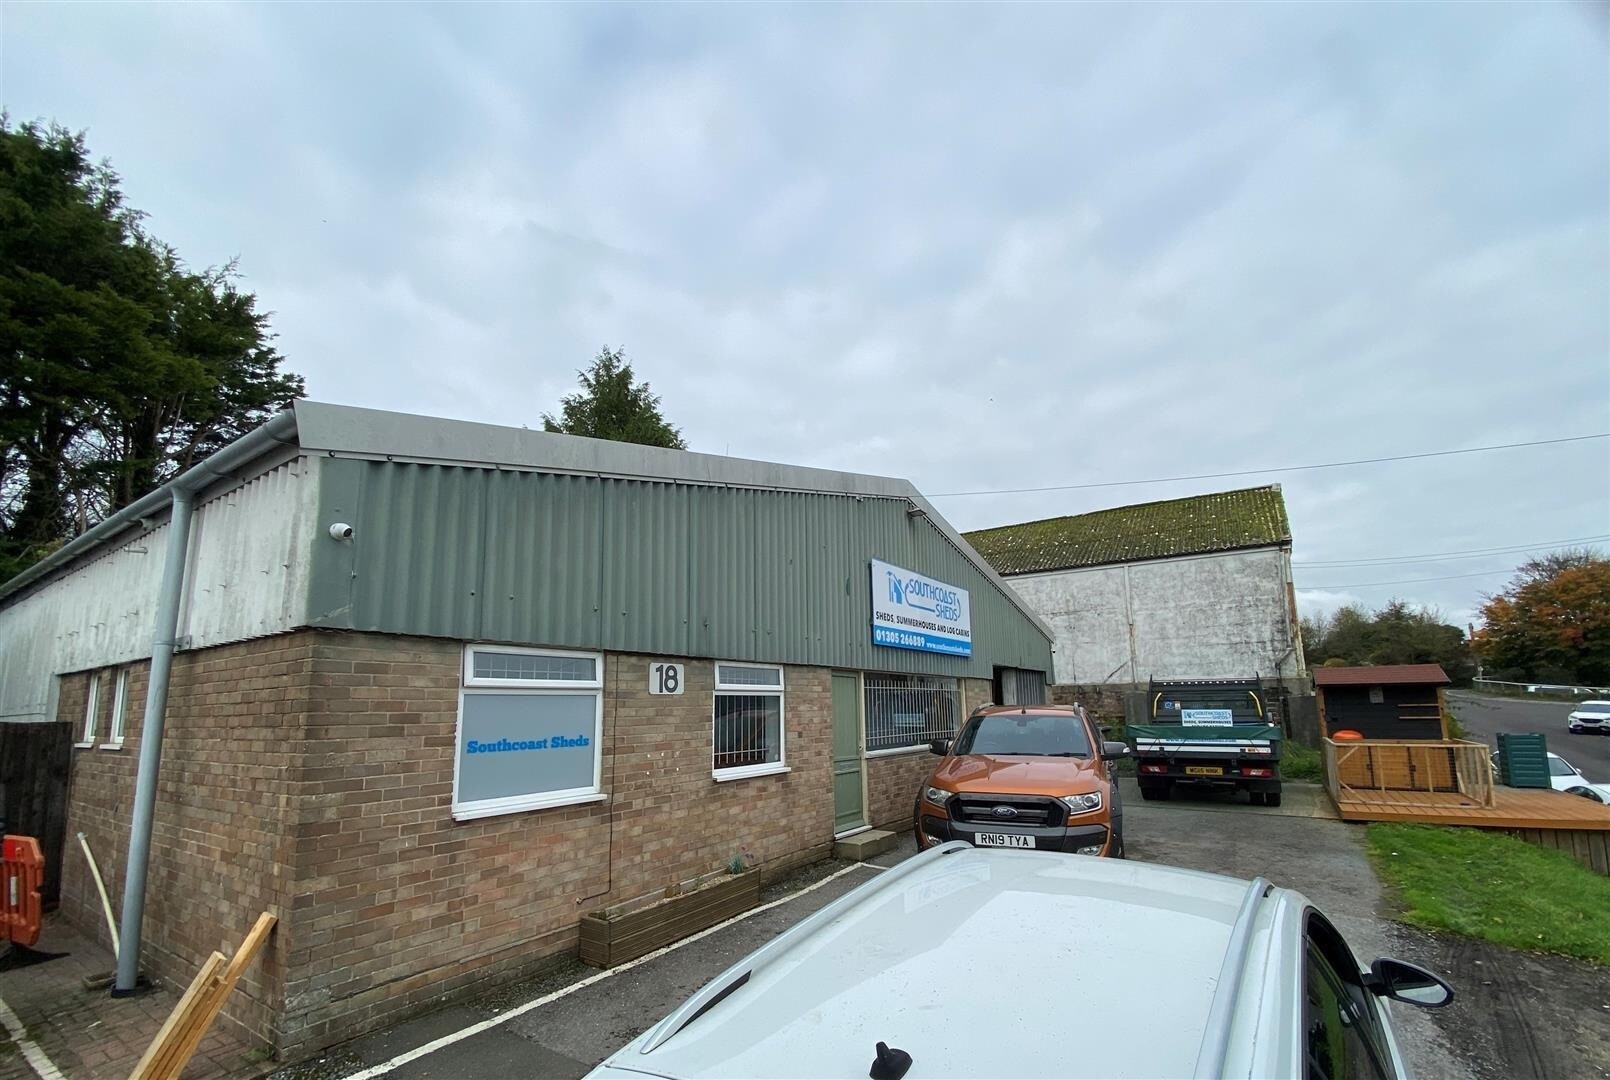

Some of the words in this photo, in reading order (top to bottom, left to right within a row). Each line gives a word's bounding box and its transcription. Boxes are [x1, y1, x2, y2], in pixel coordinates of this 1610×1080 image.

[909, 578, 957, 606] SOUTHCOAST
[935, 603, 958, 621] SHEDS
[875, 611, 895, 624] SHEDS,
[896, 615, 937, 631] SUMMERHOUSES
[937, 624, 947, 633] AND
[947, 626, 955, 635] LOG
[955, 627, 970, 637] CABINS
[876, 629, 900, 644] 01305
[656, 664, 678, 693] 18
[466, 738, 548, 754] Southcoast
[551, 734, 590, 749] Sheds
[981, 834, 1005, 845] RN19
[1007, 836, 1029, 847] TYA
